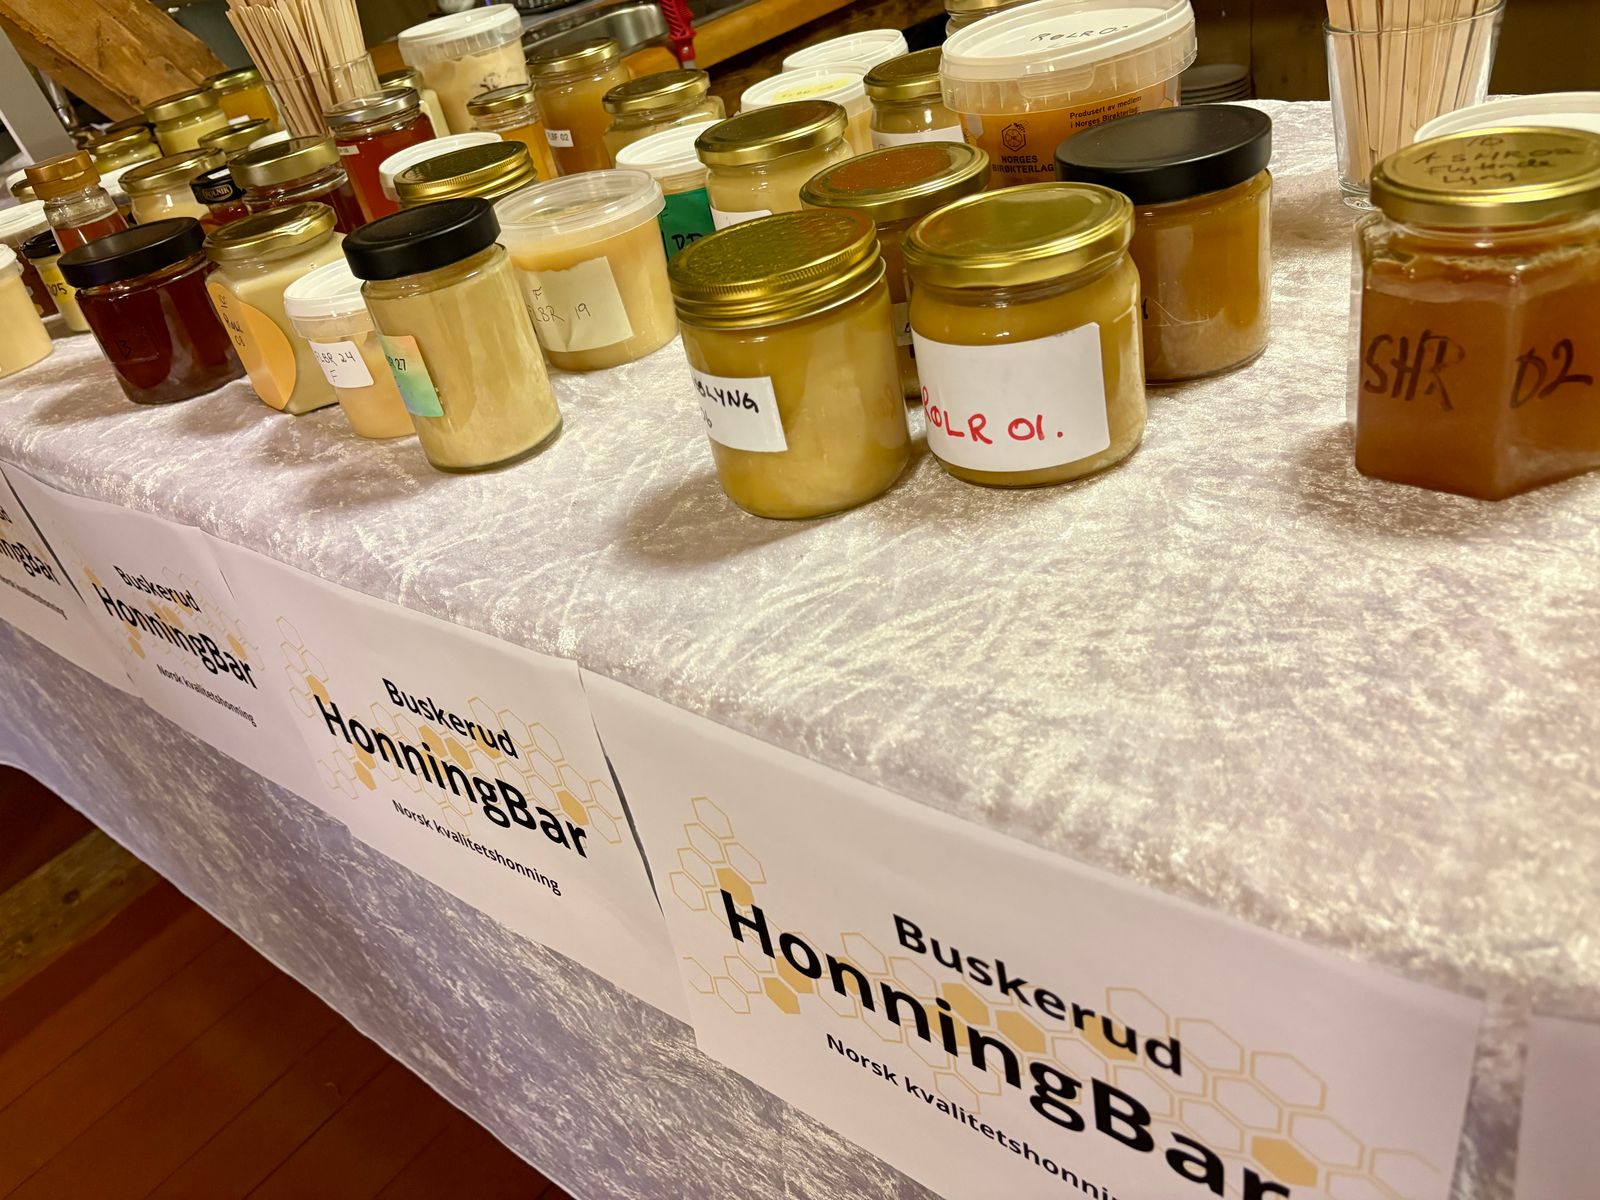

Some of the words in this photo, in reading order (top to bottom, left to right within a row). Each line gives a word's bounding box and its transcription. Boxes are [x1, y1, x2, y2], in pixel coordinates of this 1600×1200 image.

[1069, 106, 1106, 119] Produsert
[1117, 96, 1142, 108] medlem
[1075, 117, 1100, 128] Norges
[992, 163, 1055, 174] BIRØKTERLAG
[1001, 155, 1038, 164] NORGES
[338, 351, 356, 363] 24
[394, 358, 407, 371] 27
[921, 385, 993, 445] RØLR
[112, 564, 202, 614] Buskerud
[91, 582, 258, 690] HonningBar
[381, 677, 519, 760] Buskerud
[313, 693, 588, 860] HonningBar
[392, 799, 434, 831] Norsk
[434, 822, 562, 897] kvalitetshonning
[893, 913, 1183, 1077] Buskerud
[719, 887, 1292, 1200] HonningBar
[826, 1032, 900, 1087] Norsk
[904, 1075, 1118, 1200] kvalitetshonni
